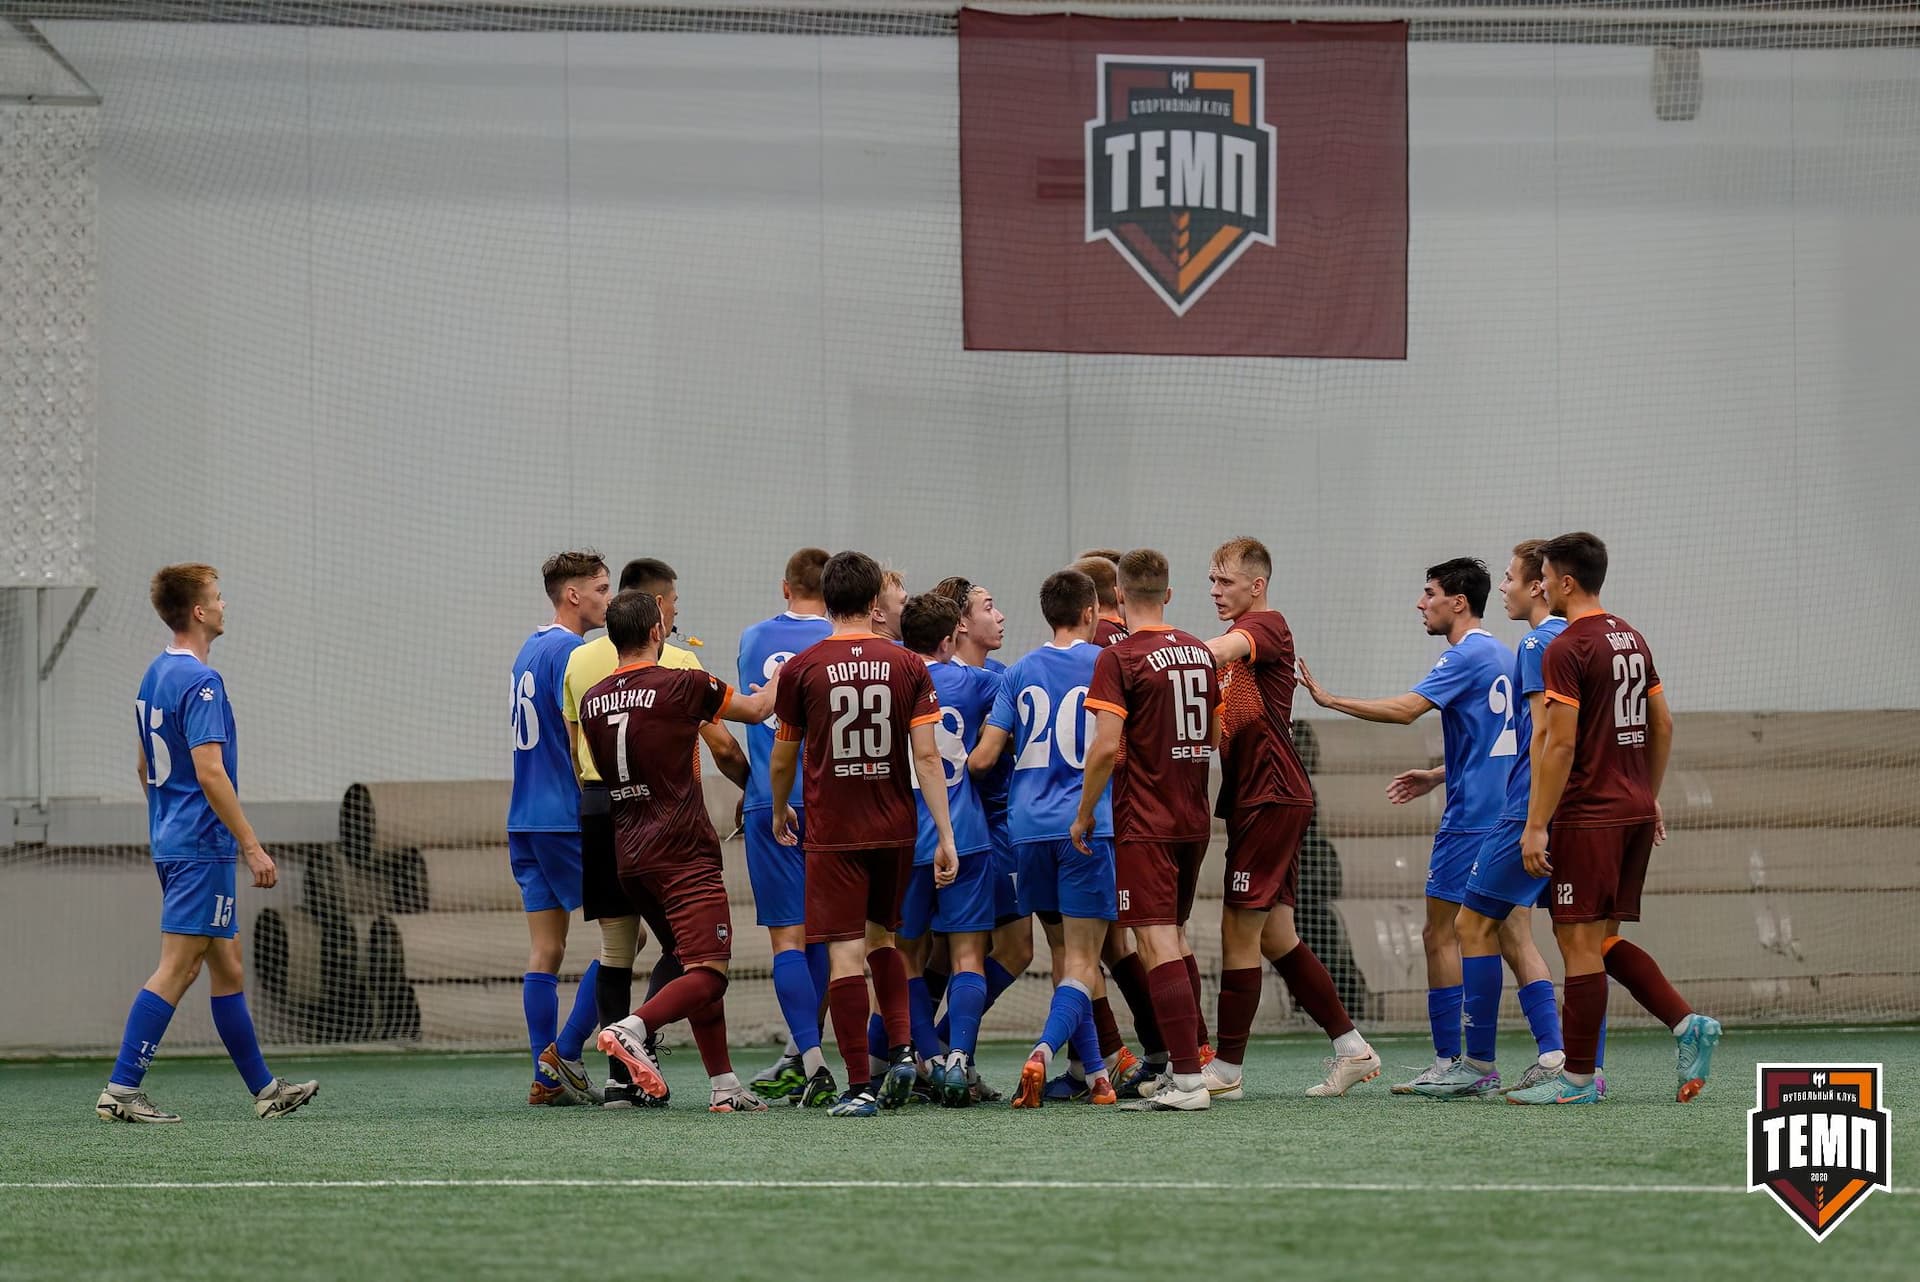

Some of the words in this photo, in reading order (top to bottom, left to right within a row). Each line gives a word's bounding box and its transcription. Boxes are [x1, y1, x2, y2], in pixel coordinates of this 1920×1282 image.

[1105, 130, 1256, 218] ТЕМП
[826, 661, 891, 684] ВОРОНА
[1612, 653, 1647, 728] 22
[829, 684, 892, 759] 23
[1014, 685, 1097, 770] 20
[1168, 669, 1208, 741] 15
[607, 711, 630, 783] 7
[834, 762, 891, 777] SEUS
[1118, 889, 1130, 911] 15
[1232, 871, 1250, 892] 25
[1557, 883, 1573, 905] 22
[210, 894, 234, 928] 15
